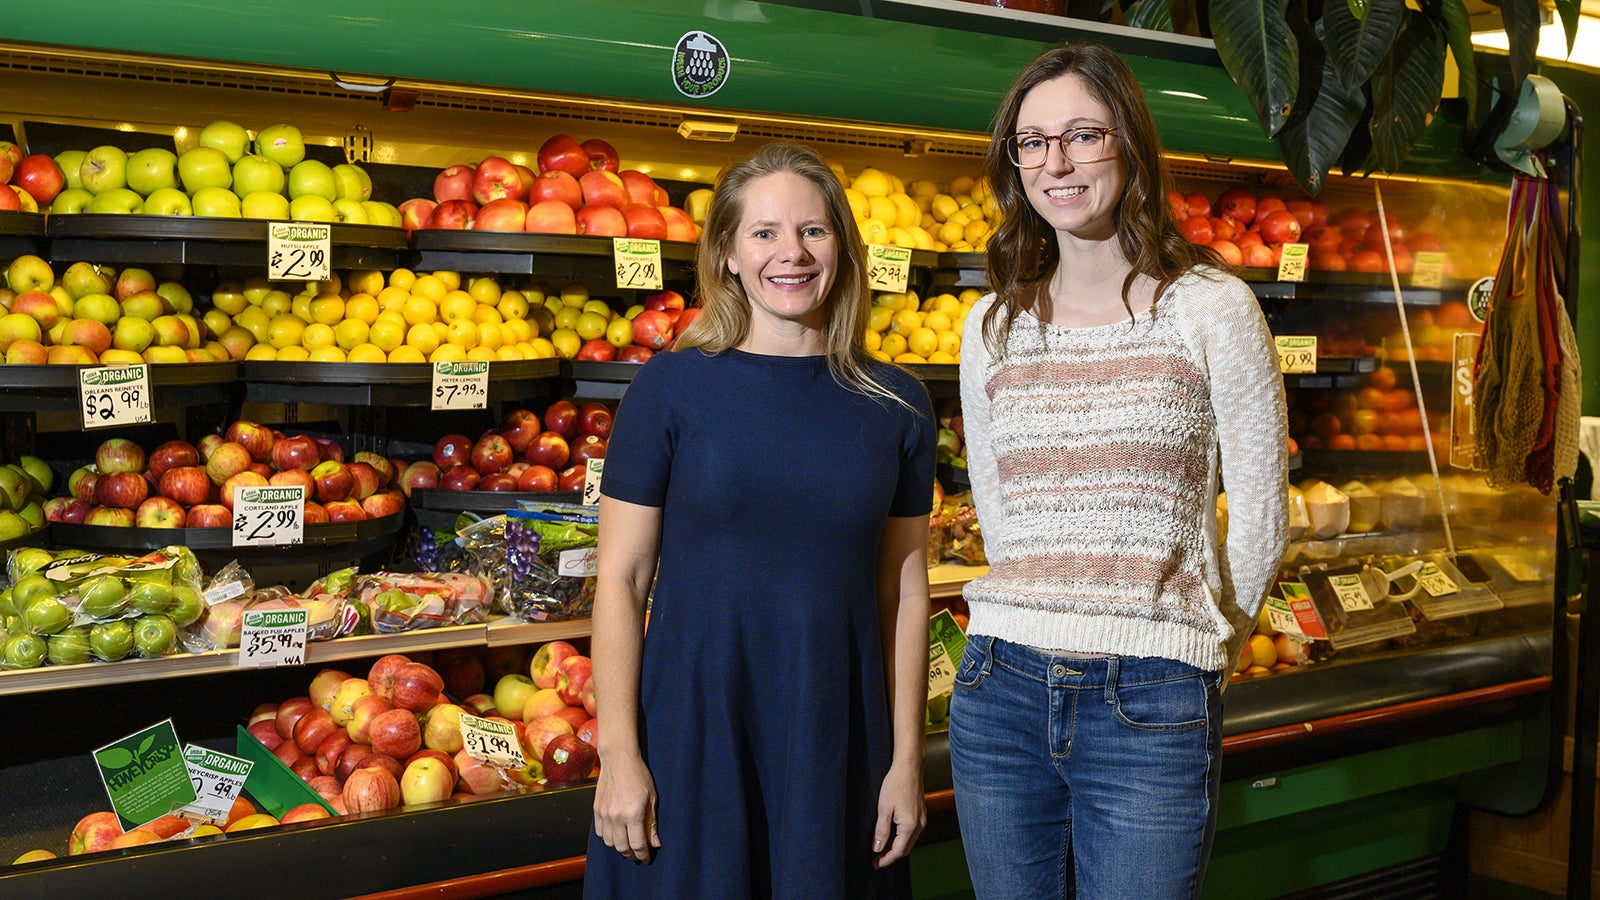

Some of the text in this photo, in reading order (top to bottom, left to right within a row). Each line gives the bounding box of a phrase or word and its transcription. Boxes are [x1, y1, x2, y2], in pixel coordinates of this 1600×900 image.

[676, 51, 726, 93] WASH YOUR PRODUCE
[291, 228, 327, 239] ORGANIC
[631, 242, 658, 252] ORGANIC
[271, 249, 324, 277] $2.99
[102, 368, 142, 381] ORGANIC
[454, 363, 486, 372] ORGANIC
[436, 384, 477, 405] $7.99
[86, 390, 140, 420] $2.99
[134, 415, 148, 423] USA
[262, 490, 300, 500] ORGANIC
[234, 510, 296, 540] $2.99
[265, 612, 304, 624] ORGANIC
[247, 632, 292, 657] $5.99
[284, 656, 301, 664] WA
[478, 720, 513, 735] ORGANIC
[466, 730, 510, 754] $1.99
[205, 754, 248, 774] ORGANIC
[188, 768, 243, 786] NEYCRISP APPLES
